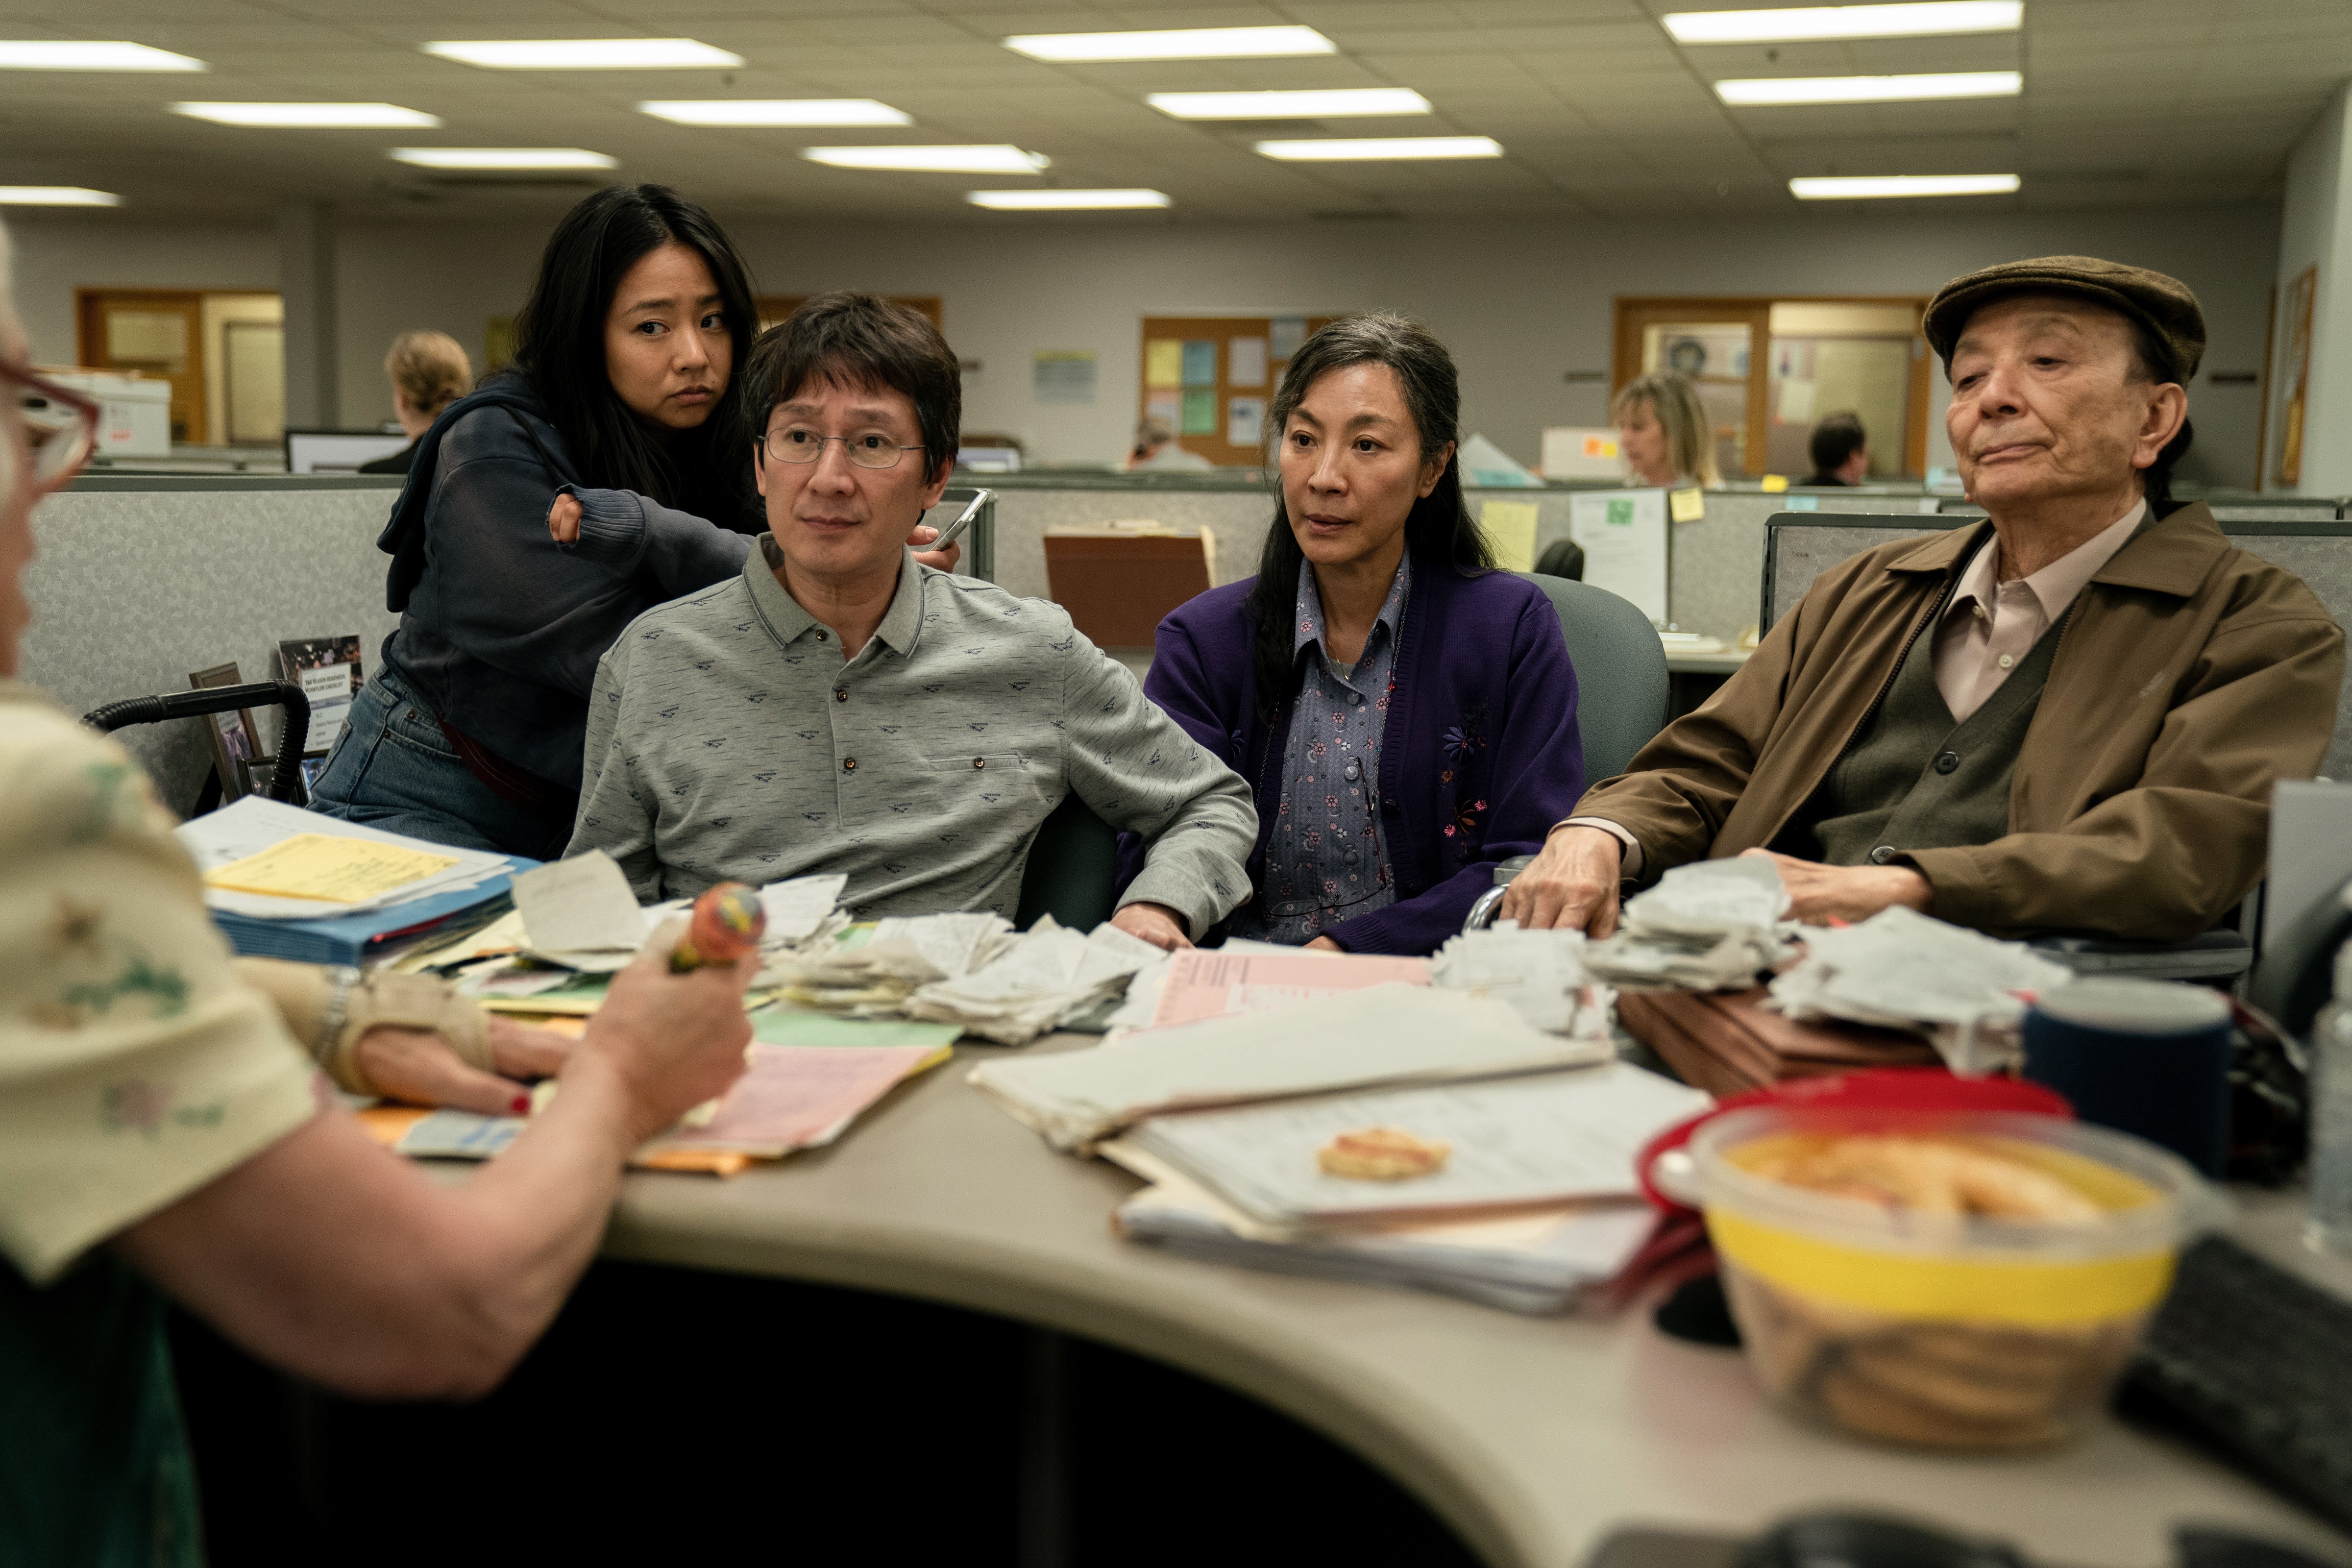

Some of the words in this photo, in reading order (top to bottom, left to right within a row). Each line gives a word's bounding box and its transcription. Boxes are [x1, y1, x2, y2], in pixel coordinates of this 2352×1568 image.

[1104, 697, 1115, 708] FASHION
[1150, 749, 1159, 760] FASHION
[1163, 795, 1174, 809] FASHION
[1218, 883, 1231, 895] FASHION
